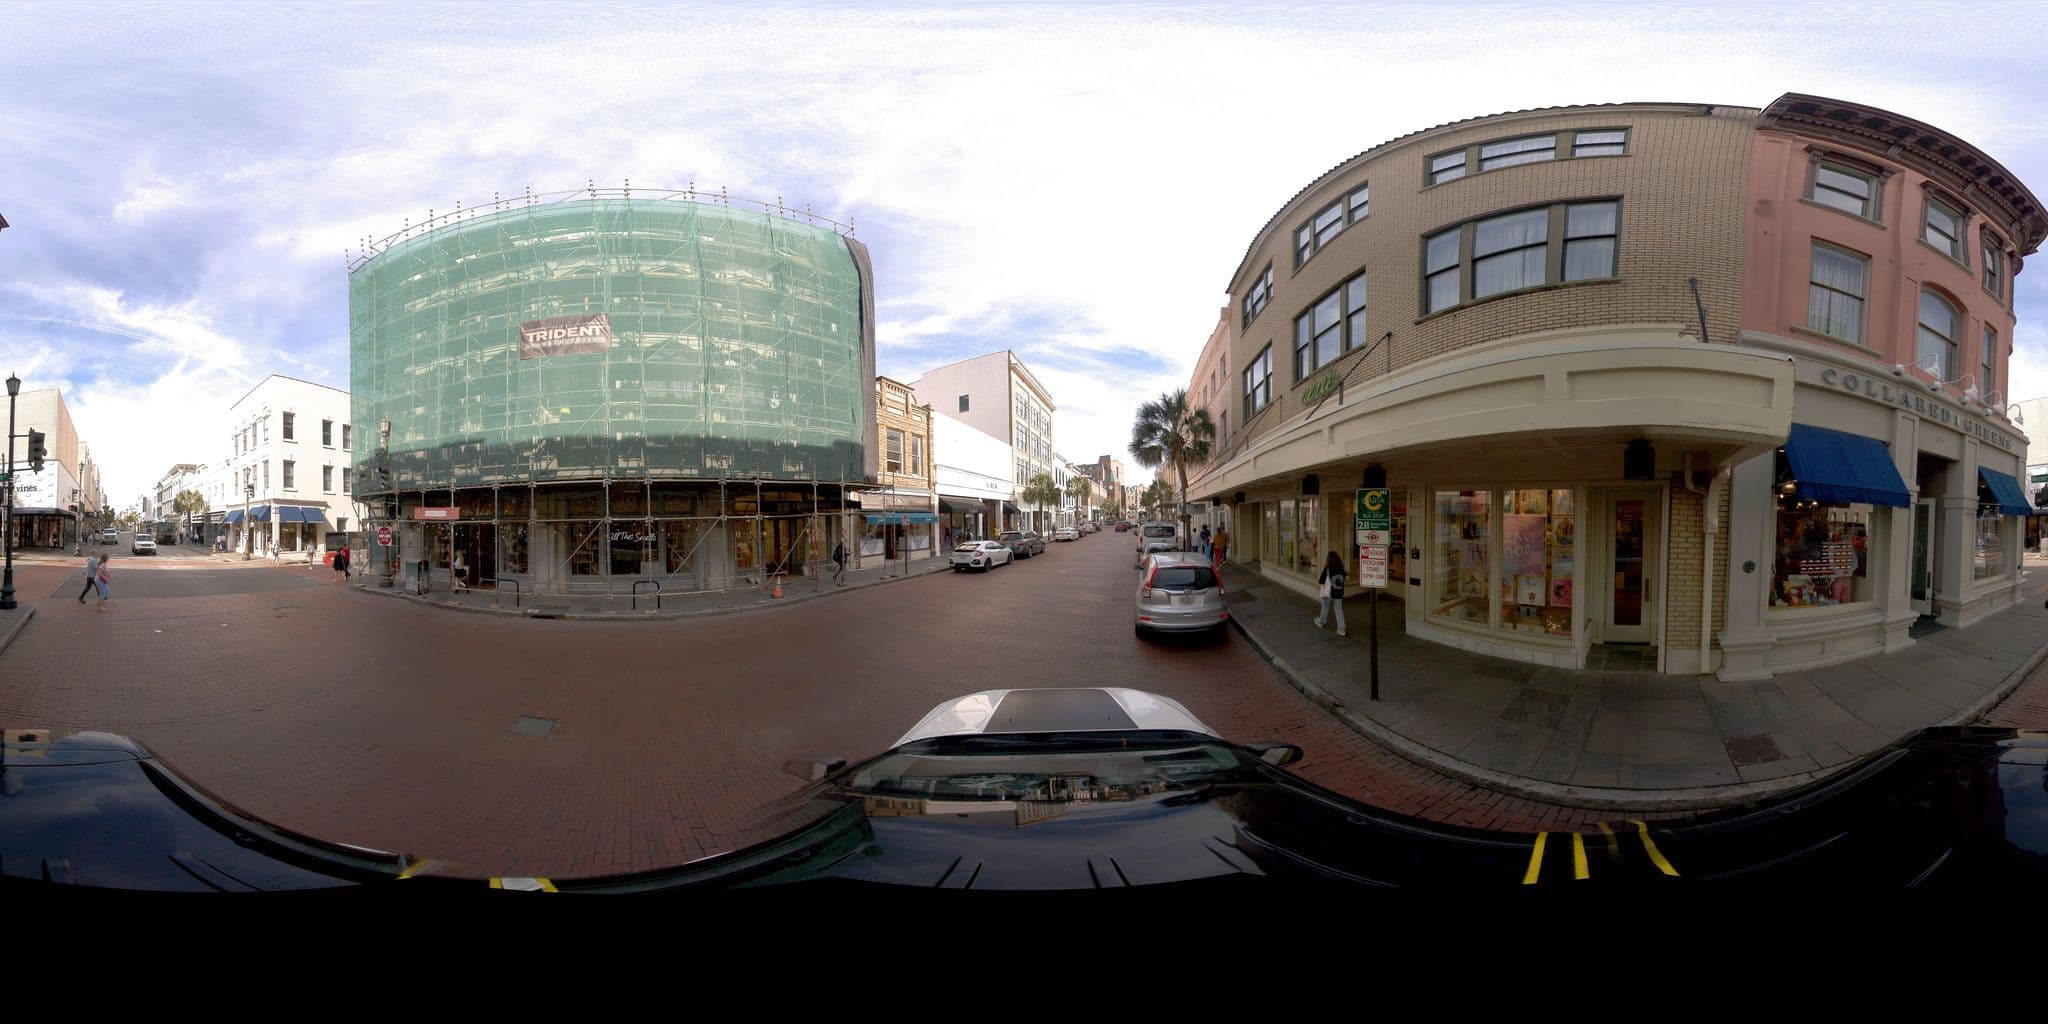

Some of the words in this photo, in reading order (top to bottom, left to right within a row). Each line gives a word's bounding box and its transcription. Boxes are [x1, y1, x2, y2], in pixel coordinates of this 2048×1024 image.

[526, 325, 605, 343] TRIDENT
[1821, 367, 1951, 423] COLLARED
[1964, 419, 2012, 450] GREENS
[16, 484, 38, 492] vines
